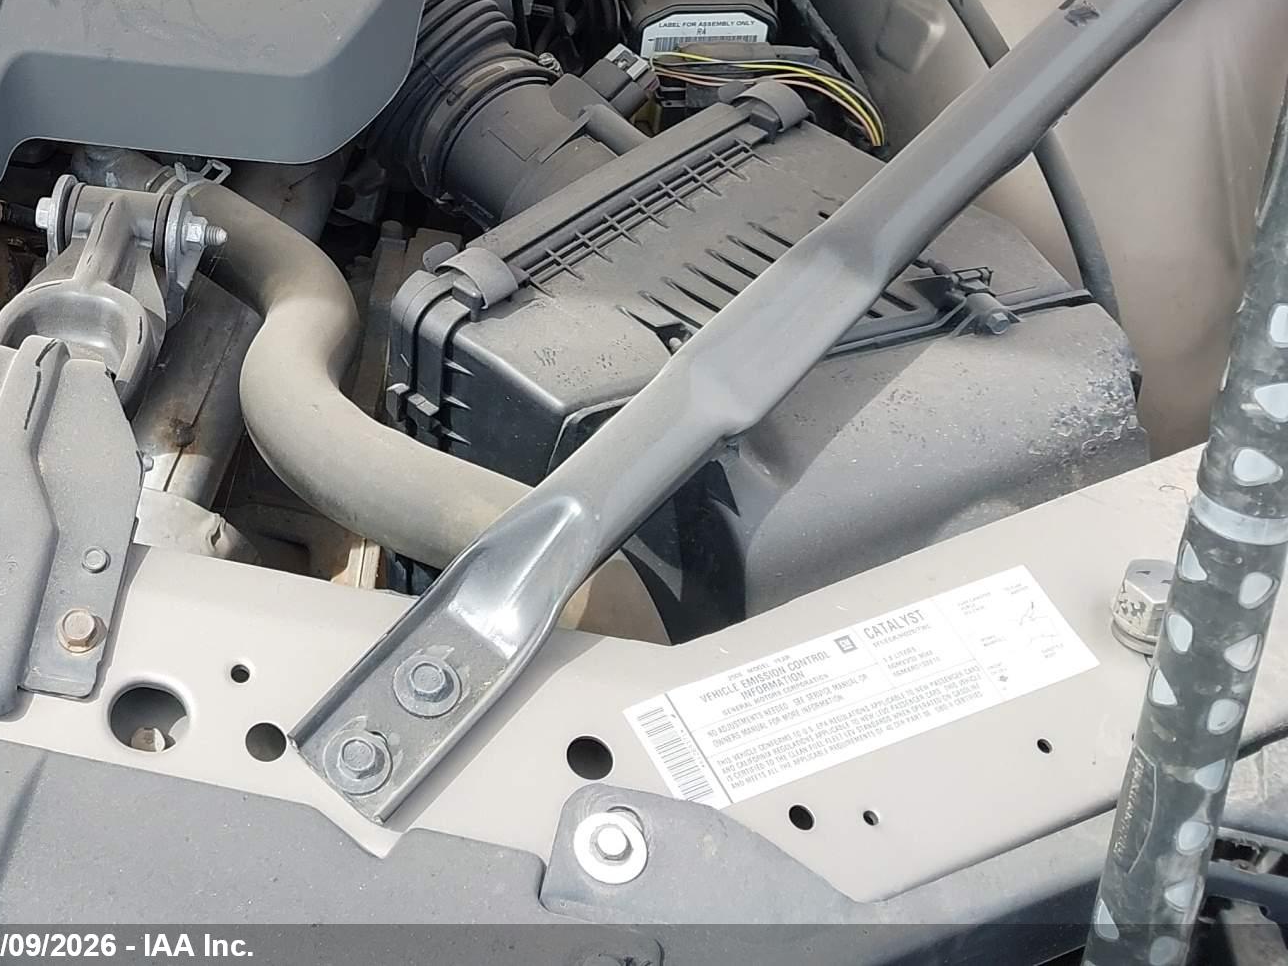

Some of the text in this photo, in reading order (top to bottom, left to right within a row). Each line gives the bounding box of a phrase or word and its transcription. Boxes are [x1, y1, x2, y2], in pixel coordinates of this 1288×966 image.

[863, 608, 926, 639] CATALYST
[699, 649, 830, 703] VEHICLE EMISSION CONTROL
[739, 669, 805, 700] INFORMATION
